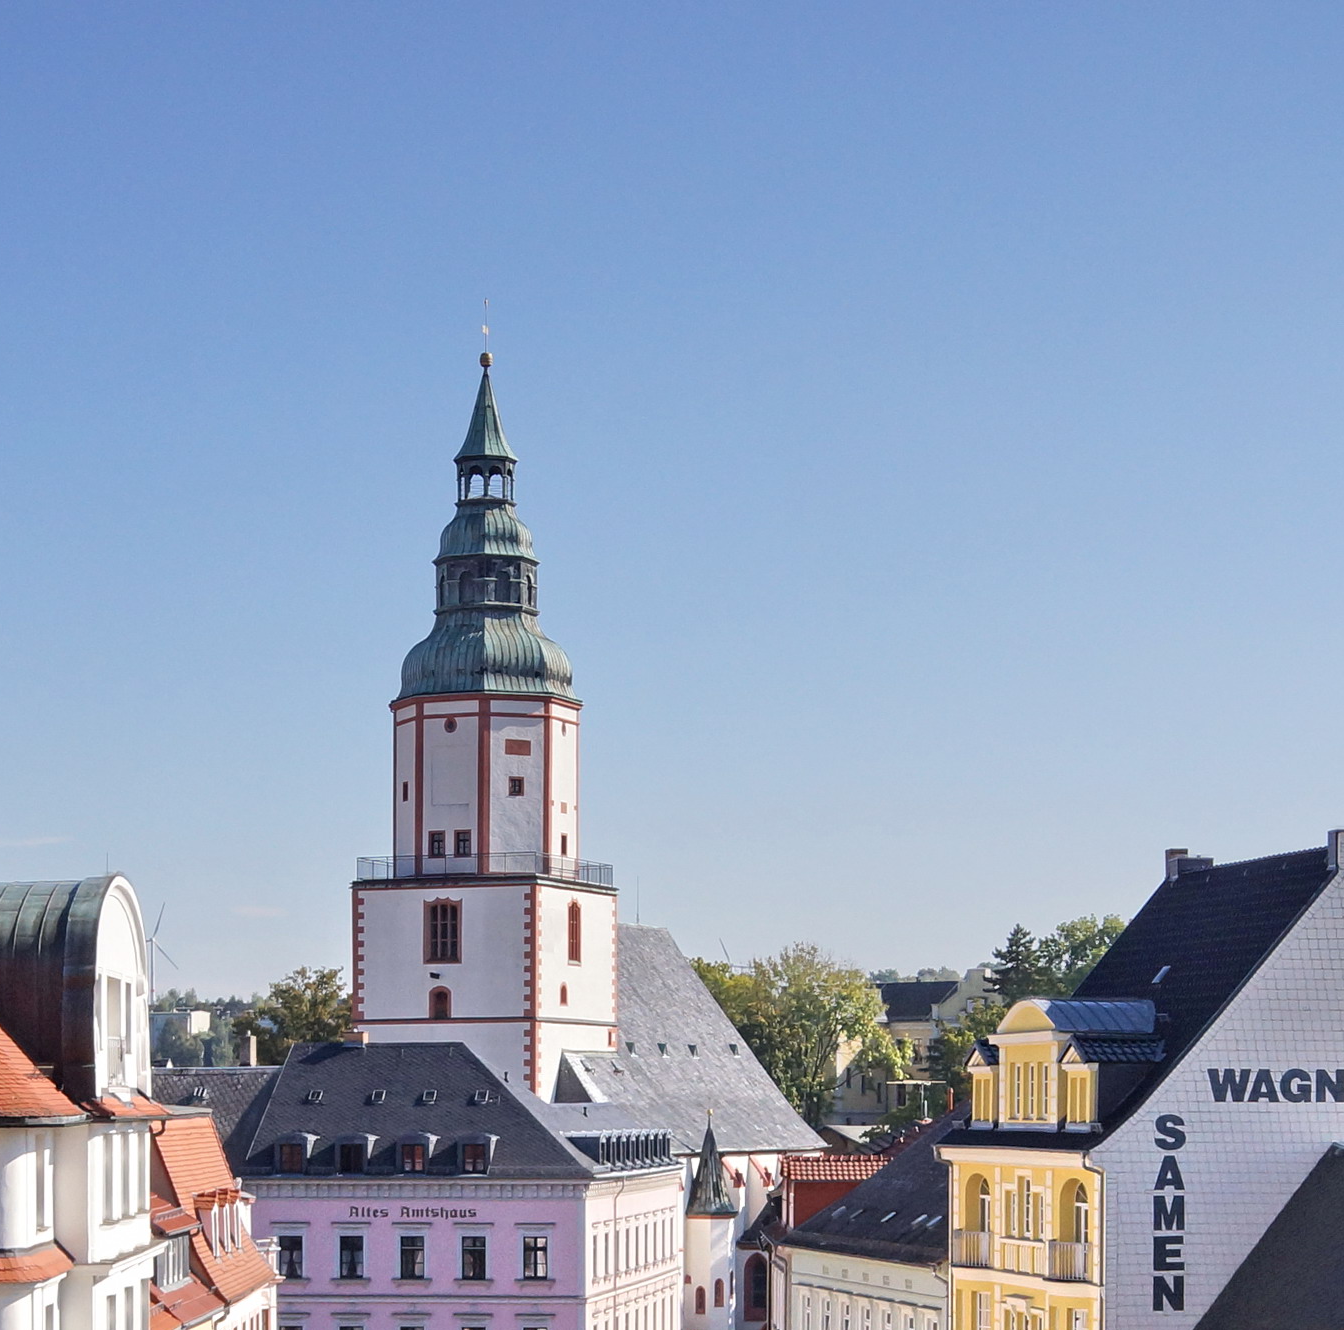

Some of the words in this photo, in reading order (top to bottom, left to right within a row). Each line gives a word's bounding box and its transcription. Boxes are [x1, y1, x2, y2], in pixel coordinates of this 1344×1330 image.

[349, 1205, 389, 1218] Altes
[400, 1205, 477, 1220] Amtshaus
[1152, 1114, 1187, 1312] SAMEN
